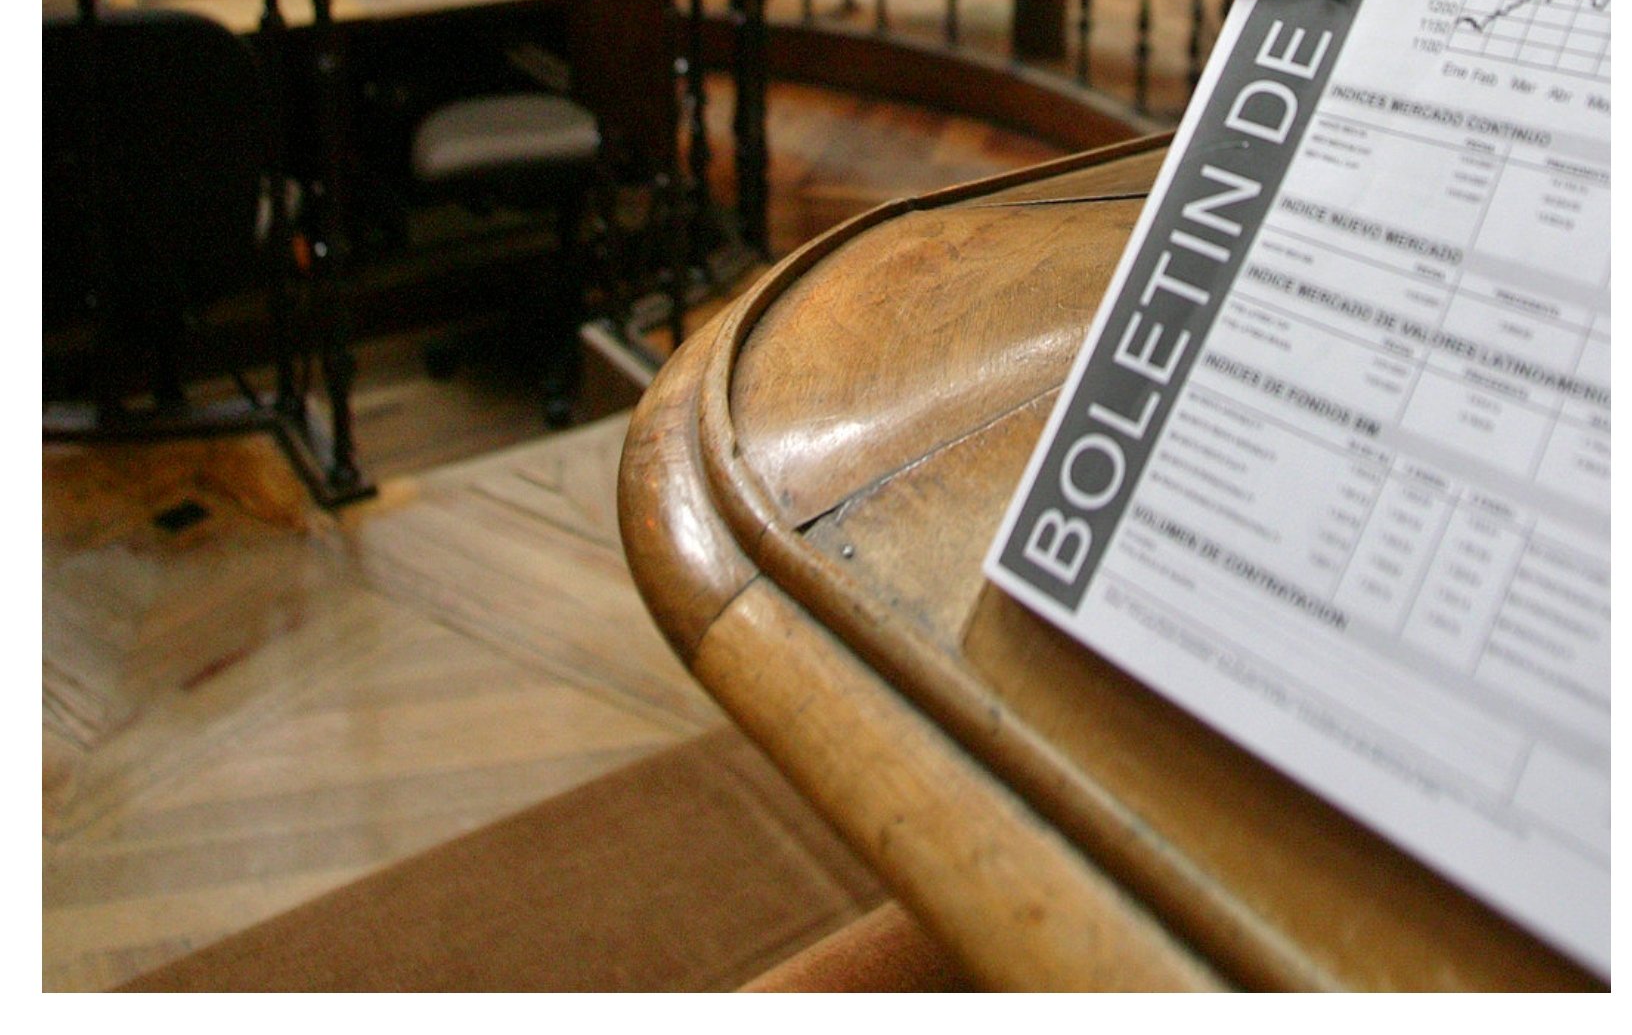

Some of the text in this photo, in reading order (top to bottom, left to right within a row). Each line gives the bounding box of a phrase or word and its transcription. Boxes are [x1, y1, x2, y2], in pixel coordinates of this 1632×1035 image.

[1225, 19, 1333, 145] DE
[1331, 84, 1552, 147] INDICES MERCADO CONTINUO
[1280, 197, 1325, 222] INDICE
[1385, 230, 1464, 263] MERCADO
[1248, 265, 1294, 292] INDICE
[1298, 283, 1372, 321] MERCADO
[1022, 163, 1264, 586] BOLETIN
